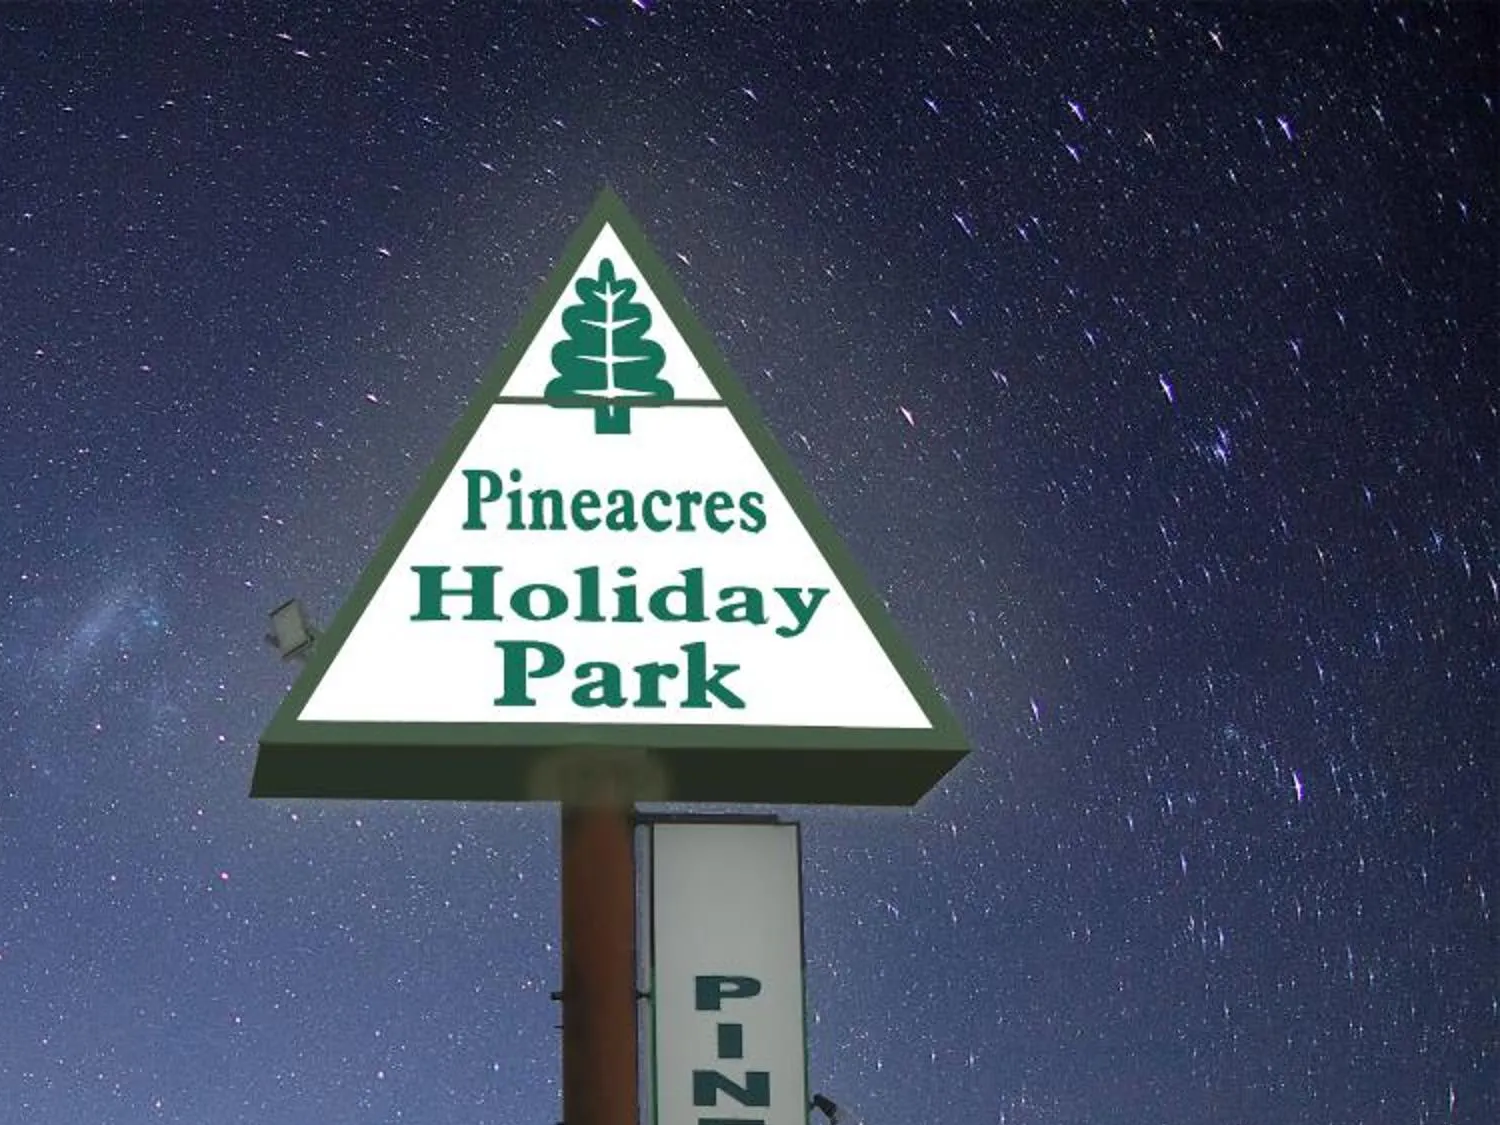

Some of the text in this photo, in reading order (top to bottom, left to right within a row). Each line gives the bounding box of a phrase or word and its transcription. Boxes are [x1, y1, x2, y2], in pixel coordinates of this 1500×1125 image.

[461, 469, 767, 532] Pineacres
[410, 565, 830, 638] Holiday
[493, 640, 746, 709] Park
